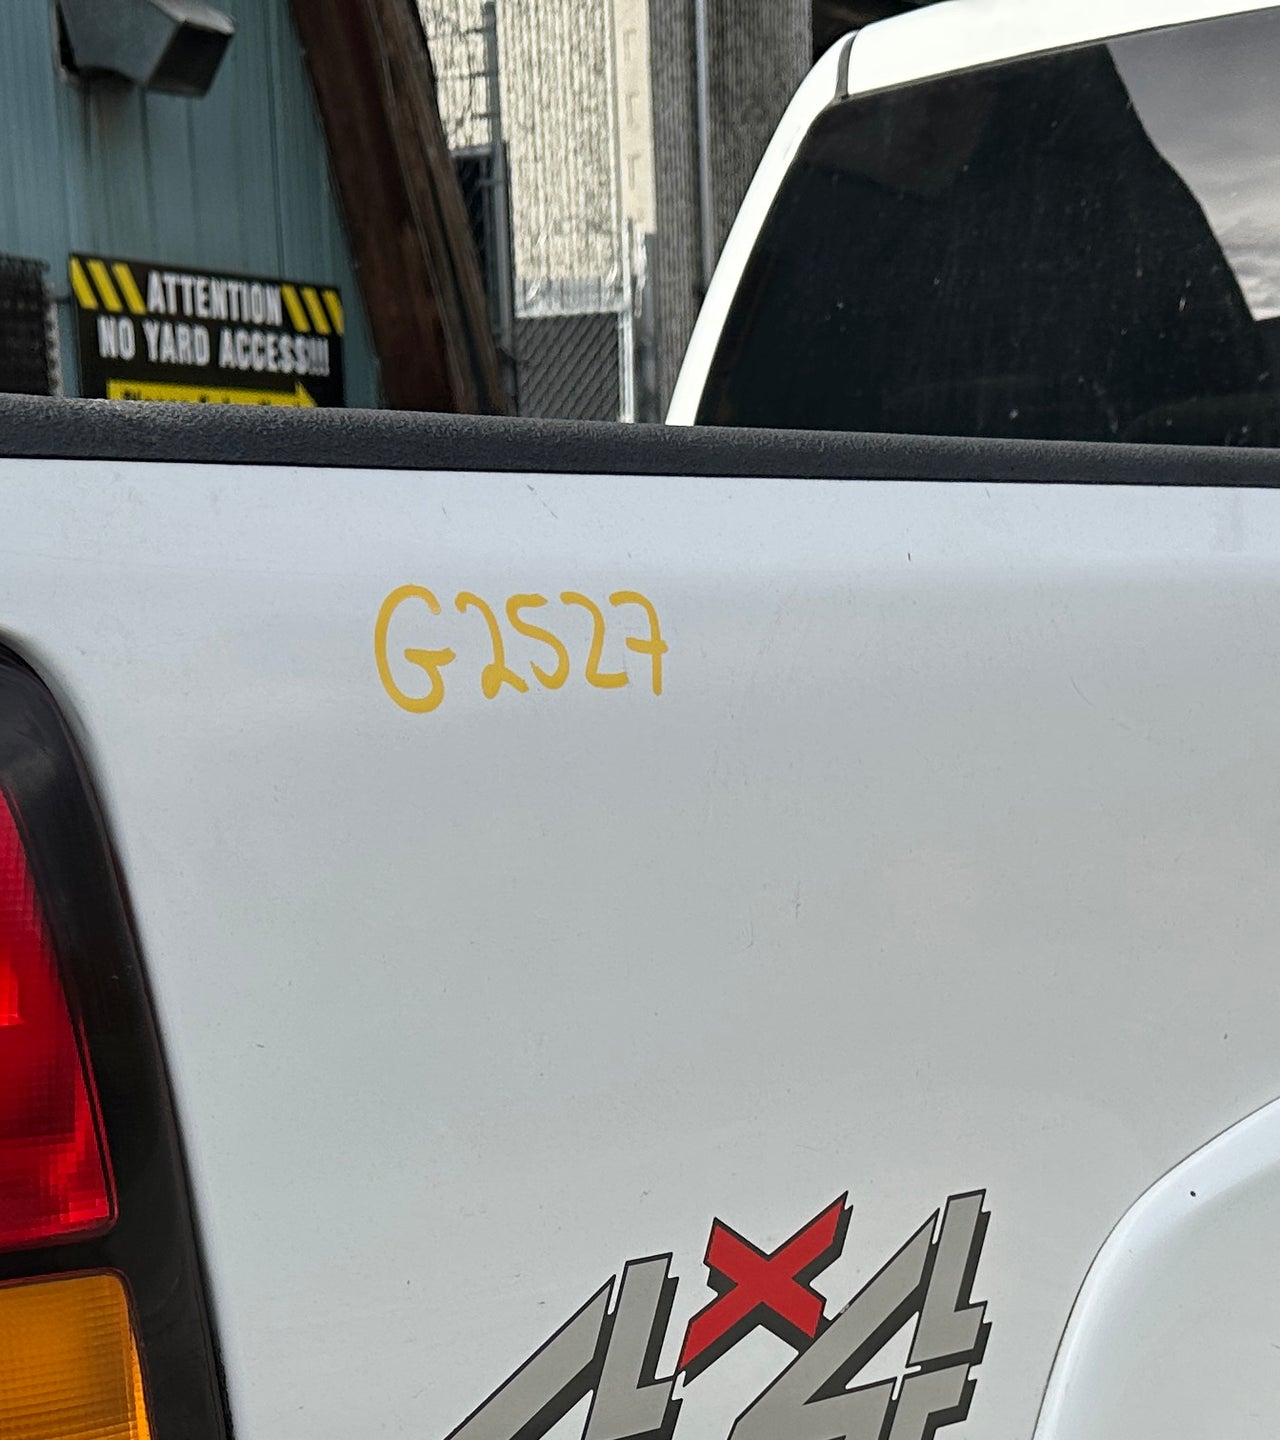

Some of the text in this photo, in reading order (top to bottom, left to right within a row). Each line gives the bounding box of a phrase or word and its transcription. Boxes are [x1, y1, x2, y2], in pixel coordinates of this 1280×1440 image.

[147, 270, 283, 327] ATTENTION
[97, 315, 136, 361] NO
[142, 319, 210, 367] YARD
[374, 583, 669, 714] G2527
